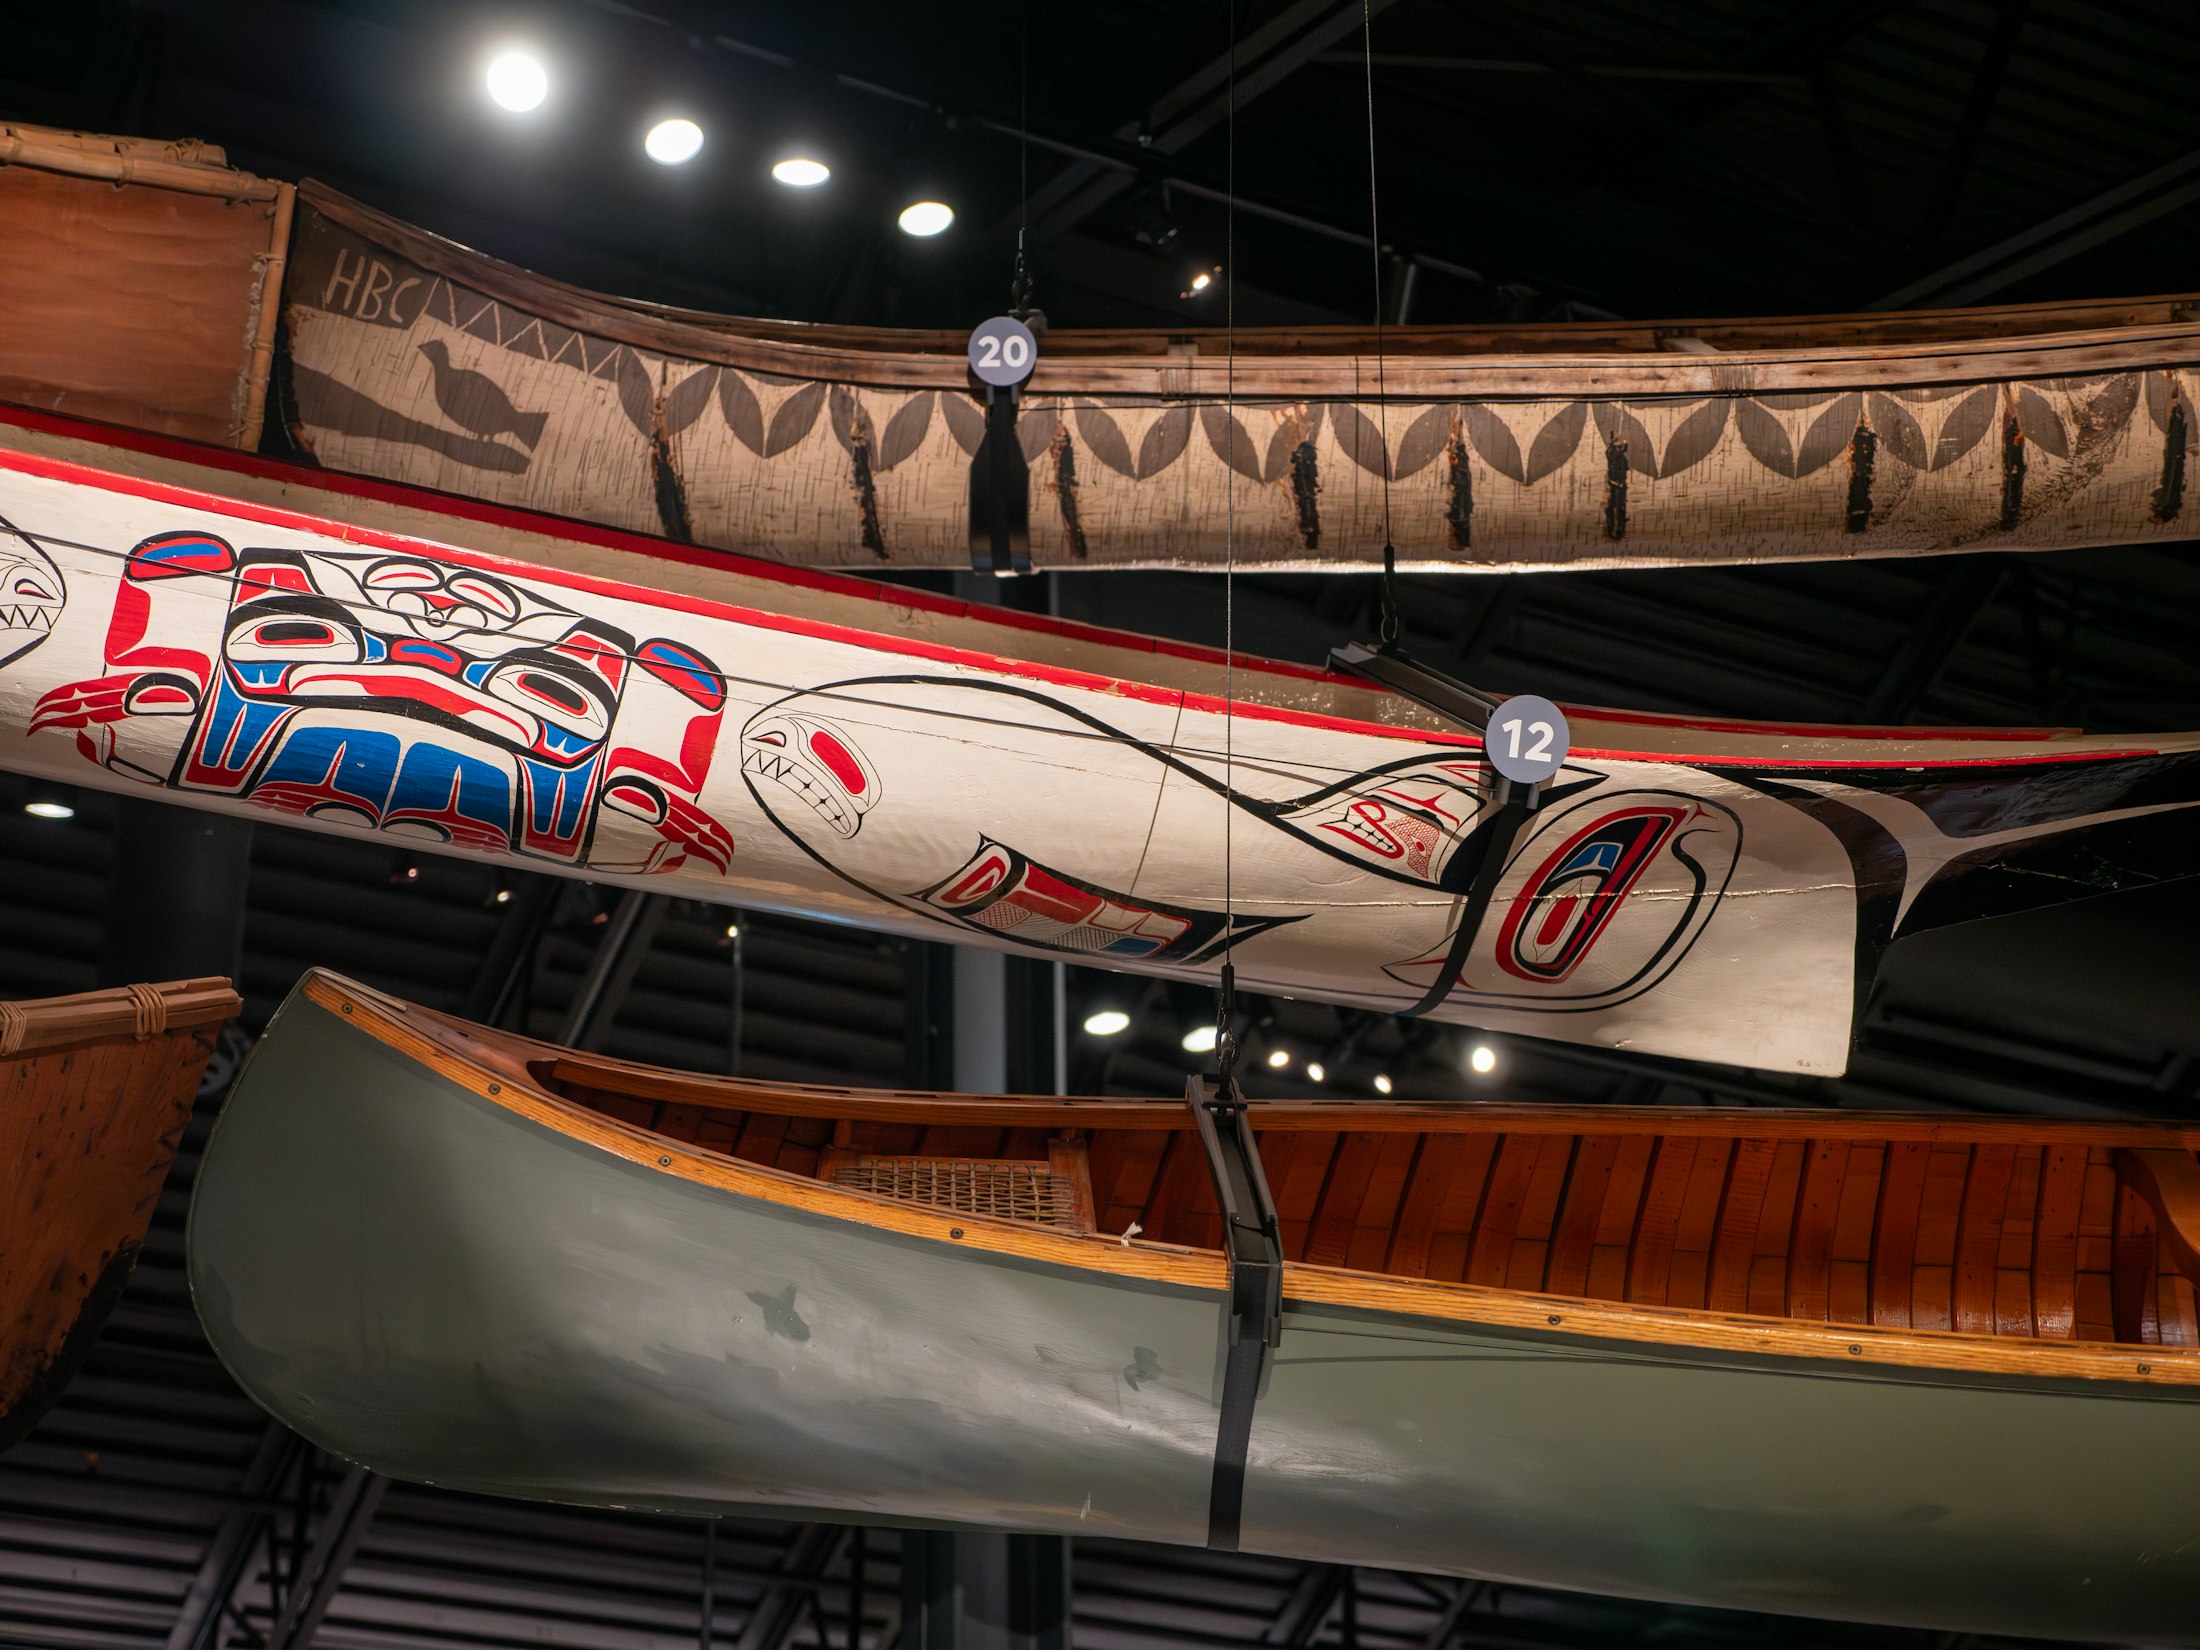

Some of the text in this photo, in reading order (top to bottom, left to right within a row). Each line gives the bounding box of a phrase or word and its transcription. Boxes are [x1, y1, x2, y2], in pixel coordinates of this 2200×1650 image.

[323, 248, 422, 324] HBC
[977, 335, 1029, 368] 20
[1501, 718, 1554, 763] 12
